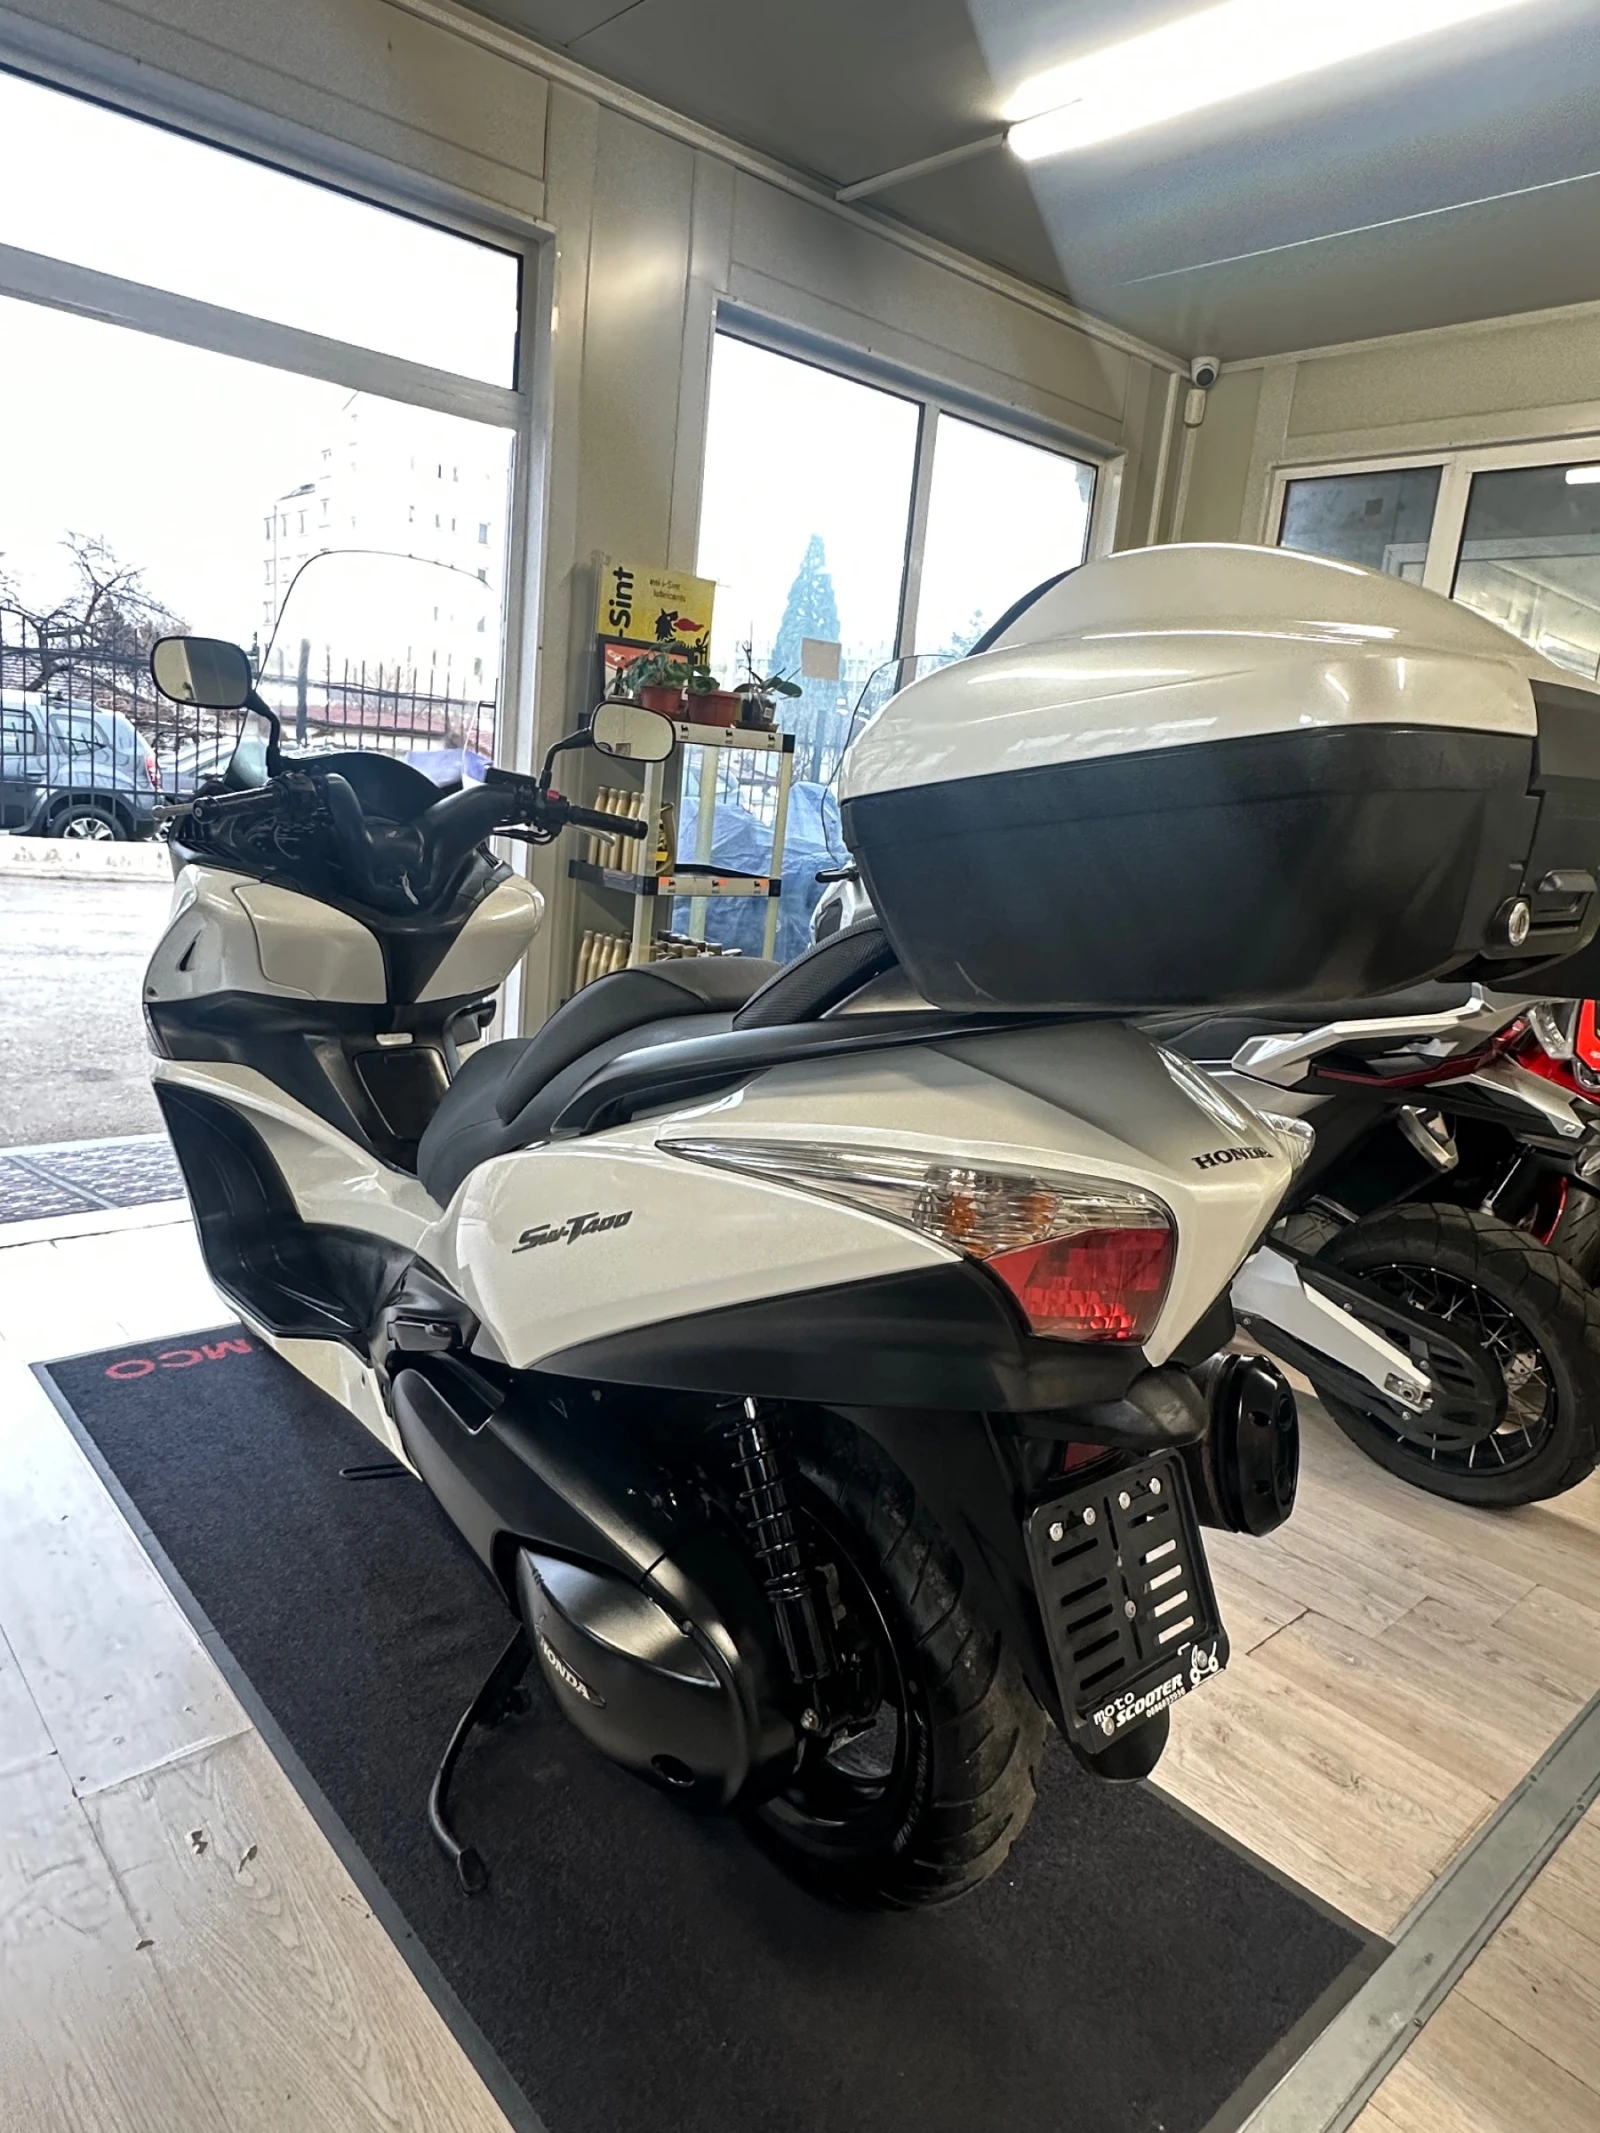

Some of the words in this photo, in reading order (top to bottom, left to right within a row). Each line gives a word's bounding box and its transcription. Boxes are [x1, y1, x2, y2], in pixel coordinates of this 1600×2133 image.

[1191, 1146, 1275, 1170] HONDA
[540, 1635, 591, 1701] HONDA
[1093, 1692, 1135, 1726] moto
[1116, 1673, 1183, 1727] SCOOTER
